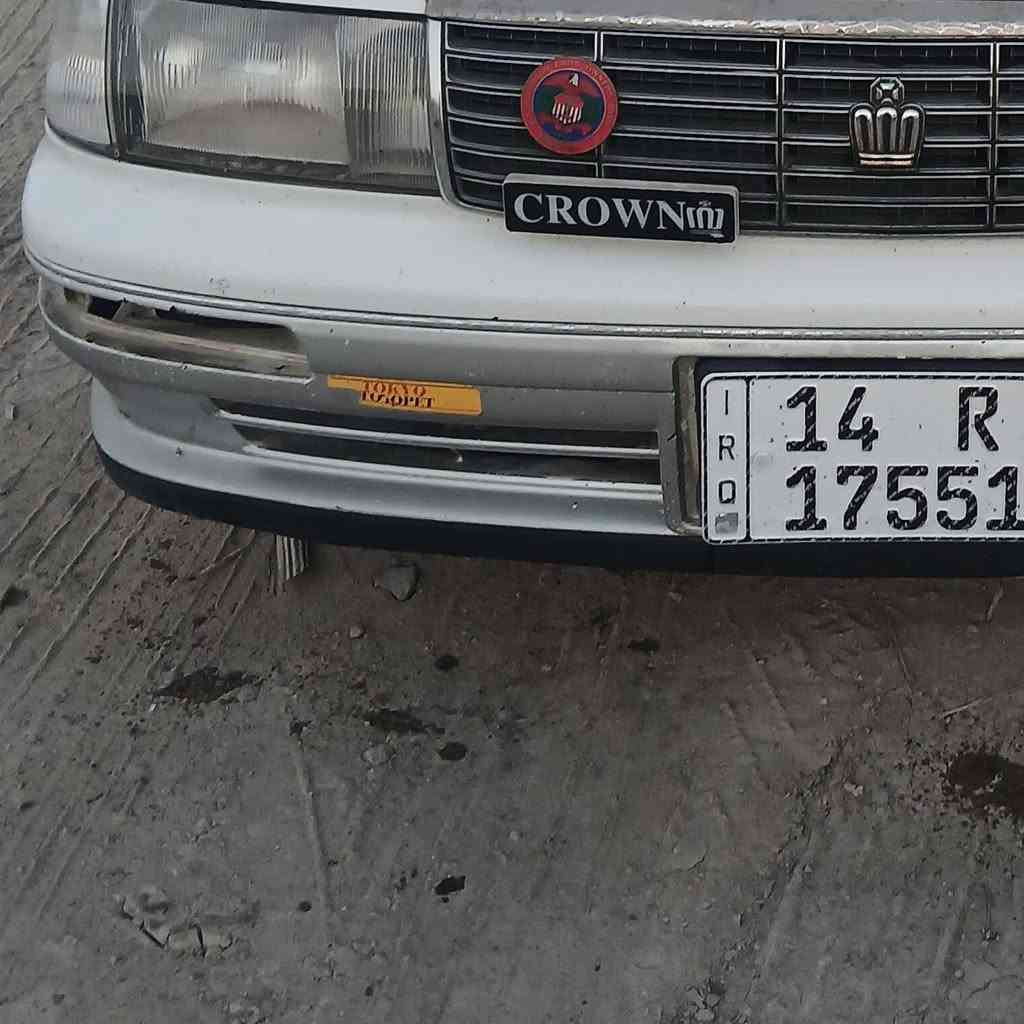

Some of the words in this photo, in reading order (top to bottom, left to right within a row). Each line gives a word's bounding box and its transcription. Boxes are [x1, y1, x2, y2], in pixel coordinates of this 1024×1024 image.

[513, 192, 687, 232] CROWN
[785, 386, 879, 452] 14
[958, 386, 1000, 452] R
